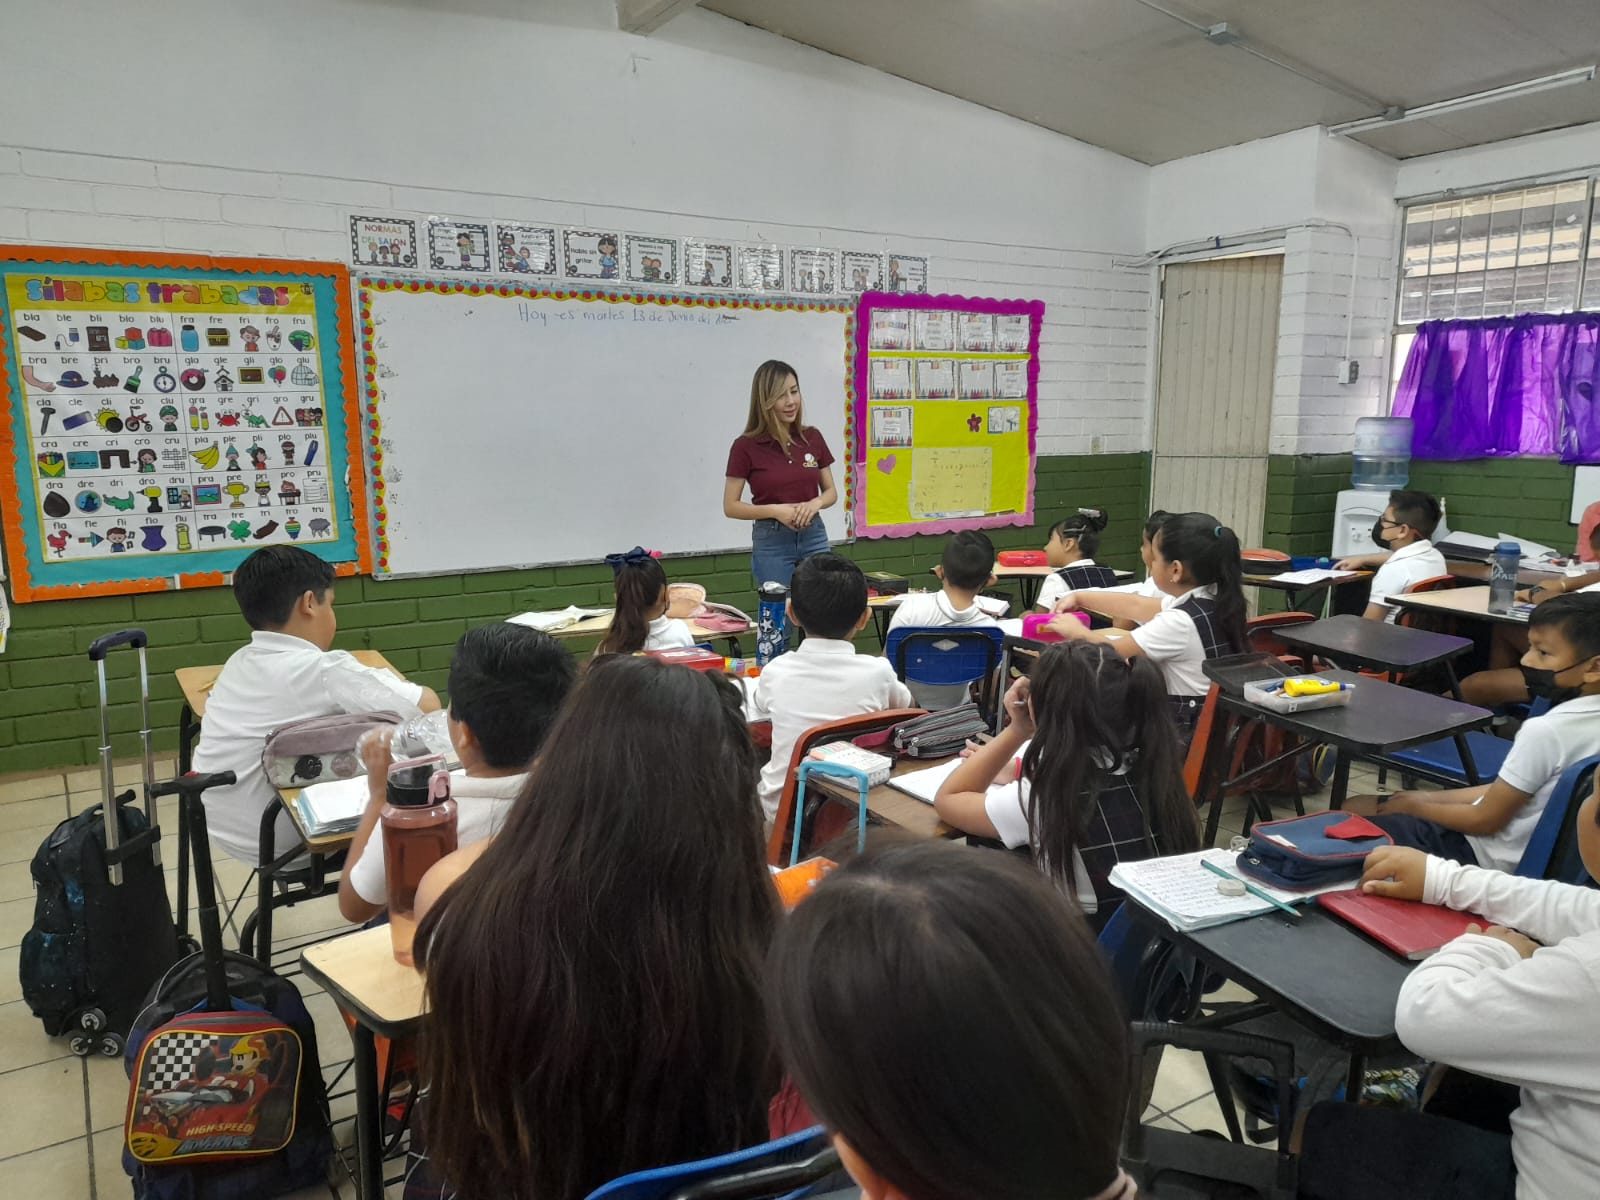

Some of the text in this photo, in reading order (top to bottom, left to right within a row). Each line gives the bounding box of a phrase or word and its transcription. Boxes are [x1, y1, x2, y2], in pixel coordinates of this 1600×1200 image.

[365, 224, 401, 234] NORMAS
[146, 282, 290, 306] trabadas
[23, 313, 41, 321] bla
[56, 314, 72, 322] ble
[89, 314, 103, 322] bli
[119, 315, 135, 323] blo
[180, 315, 306, 325] fra fre fri fro fru
[518, 303, 547, 327] Hoy
[583, 305, 625, 320] martes
[632, 308, 646, 321] 13
[28, 356, 171, 365] bra bre bri bro bru
[184, 356, 200, 365] gla
[213, 356, 228, 365] gle
[243, 356, 255, 365] gli
[269, 356, 284, 365] glo
[36, 397, 174, 407] cla cle cli clo clu
[188, 395, 315, 406] gra gre gri gro gru
[40, 437, 180, 449] cra cre cri cro cru
[194, 431, 318, 446] pla ple pli plo plu
[45, 476, 185, 489] dra dre dri dro dru
[197, 470, 322, 484] pra pre pri pro pru
[202, 511, 217, 521] tra
[230, 510, 245, 520] tre
[284, 507, 299, 516] tro
[311, 506, 324, 514] tru
[53, 521, 68, 530] fla
[145, 516, 159, 525] flo
[174, 513, 188, 523] flu
